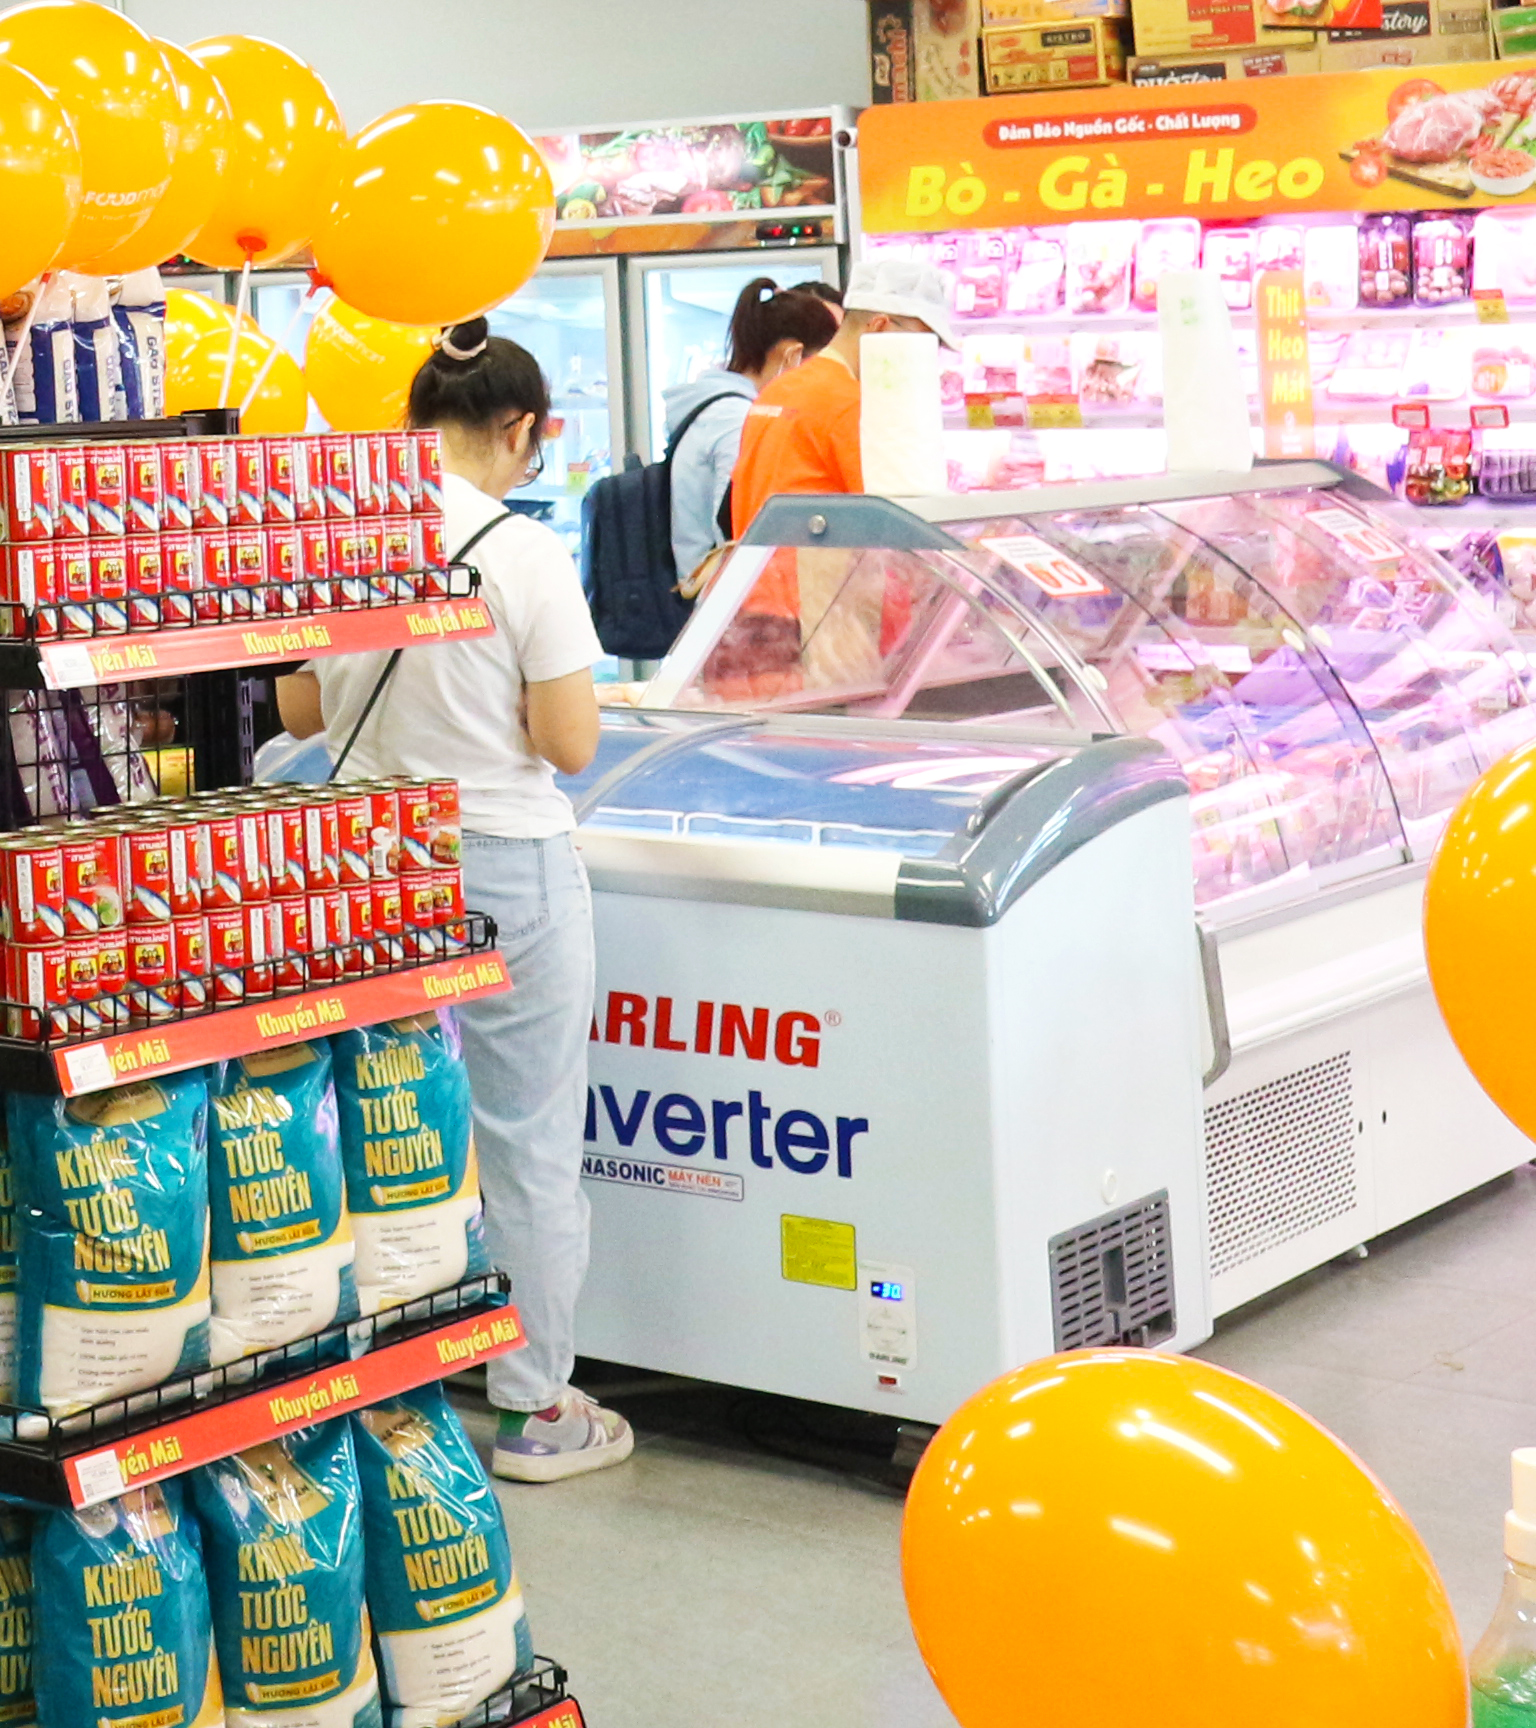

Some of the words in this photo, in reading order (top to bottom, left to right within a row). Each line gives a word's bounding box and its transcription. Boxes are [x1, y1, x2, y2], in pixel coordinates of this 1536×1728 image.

[998, 120, 1030, 143] Đảm
[1033, 119, 1062, 141] Bảo
[1064, 114, 1108, 142] Nguồn
[1111, 110, 1145, 136] Gốc
[1156, 111, 1188, 132] Chất
[1191, 110, 1241, 134] Lượng
[905, 164, 987, 217] Bò
[1039, 152, 1129, 213] Gà
[1183, 148, 1325, 206] Heo
[1265, 284, 1300, 321] Thịt
[1266, 327, 1304, 361] Heo
[125, 642, 158, 671] Mãi
[241, 626, 298, 659] Khuyến
[300, 622, 333, 652] Mãi
[422, 964, 469, 1000] Khuyến
[470, 963, 504, 990] Mãi
[255, 1002, 313, 1038] Khuyến
[315, 996, 347, 1023] Mãi
[588, 990, 823, 1069] RLING
[136, 1037, 171, 1066] Mãi
[355, 1038, 425, 1090] KHỔNG
[358, 1085, 419, 1135] TƯỚC
[55, 1130, 139, 1191] KHỔNG
[221, 1125, 284, 1179] TƯỚC
[363, 1123, 444, 1178] NGUYÊN
[229, 1164, 313, 1223] NGUYÊN
[435, 1331, 485, 1367] Khuyến
[485, 1317, 521, 1349] Mãi
[268, 1385, 324, 1426] Khuyến
[325, 1373, 360, 1405] Mãi
[150, 1435, 184, 1468] Mãi
[83, 1543, 162, 1608] KHỔNG
[87, 1601, 153, 1659] TƯỚC
[92, 1646, 178, 1709] NGUYÊN
